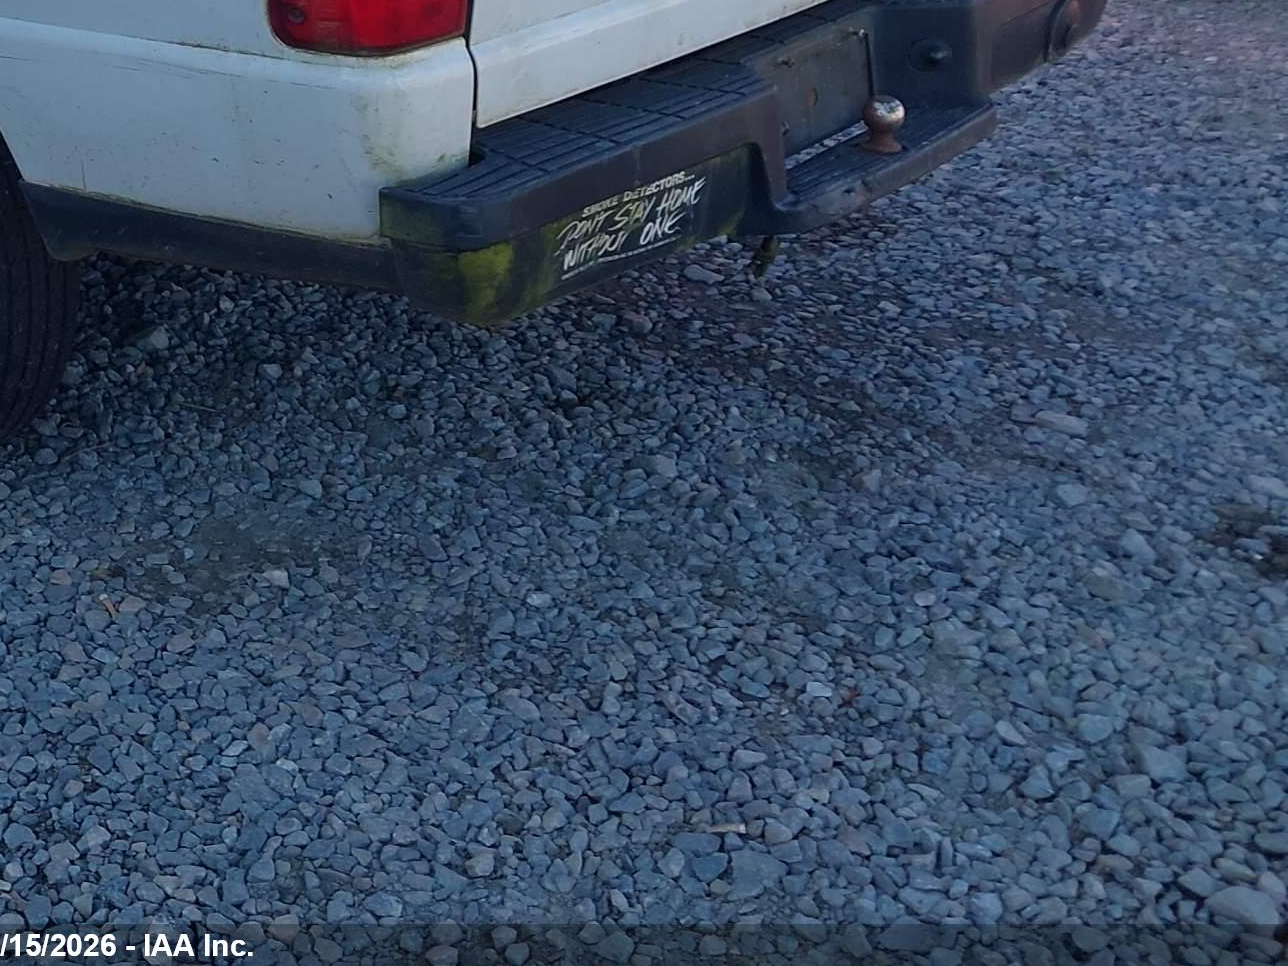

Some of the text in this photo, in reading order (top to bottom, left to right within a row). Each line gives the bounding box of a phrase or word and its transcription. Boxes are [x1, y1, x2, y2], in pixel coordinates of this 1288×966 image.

[608, 195, 657, 231] STAY
[655, 176, 707, 218] HOME
[639, 211, 687, 246] ONE
